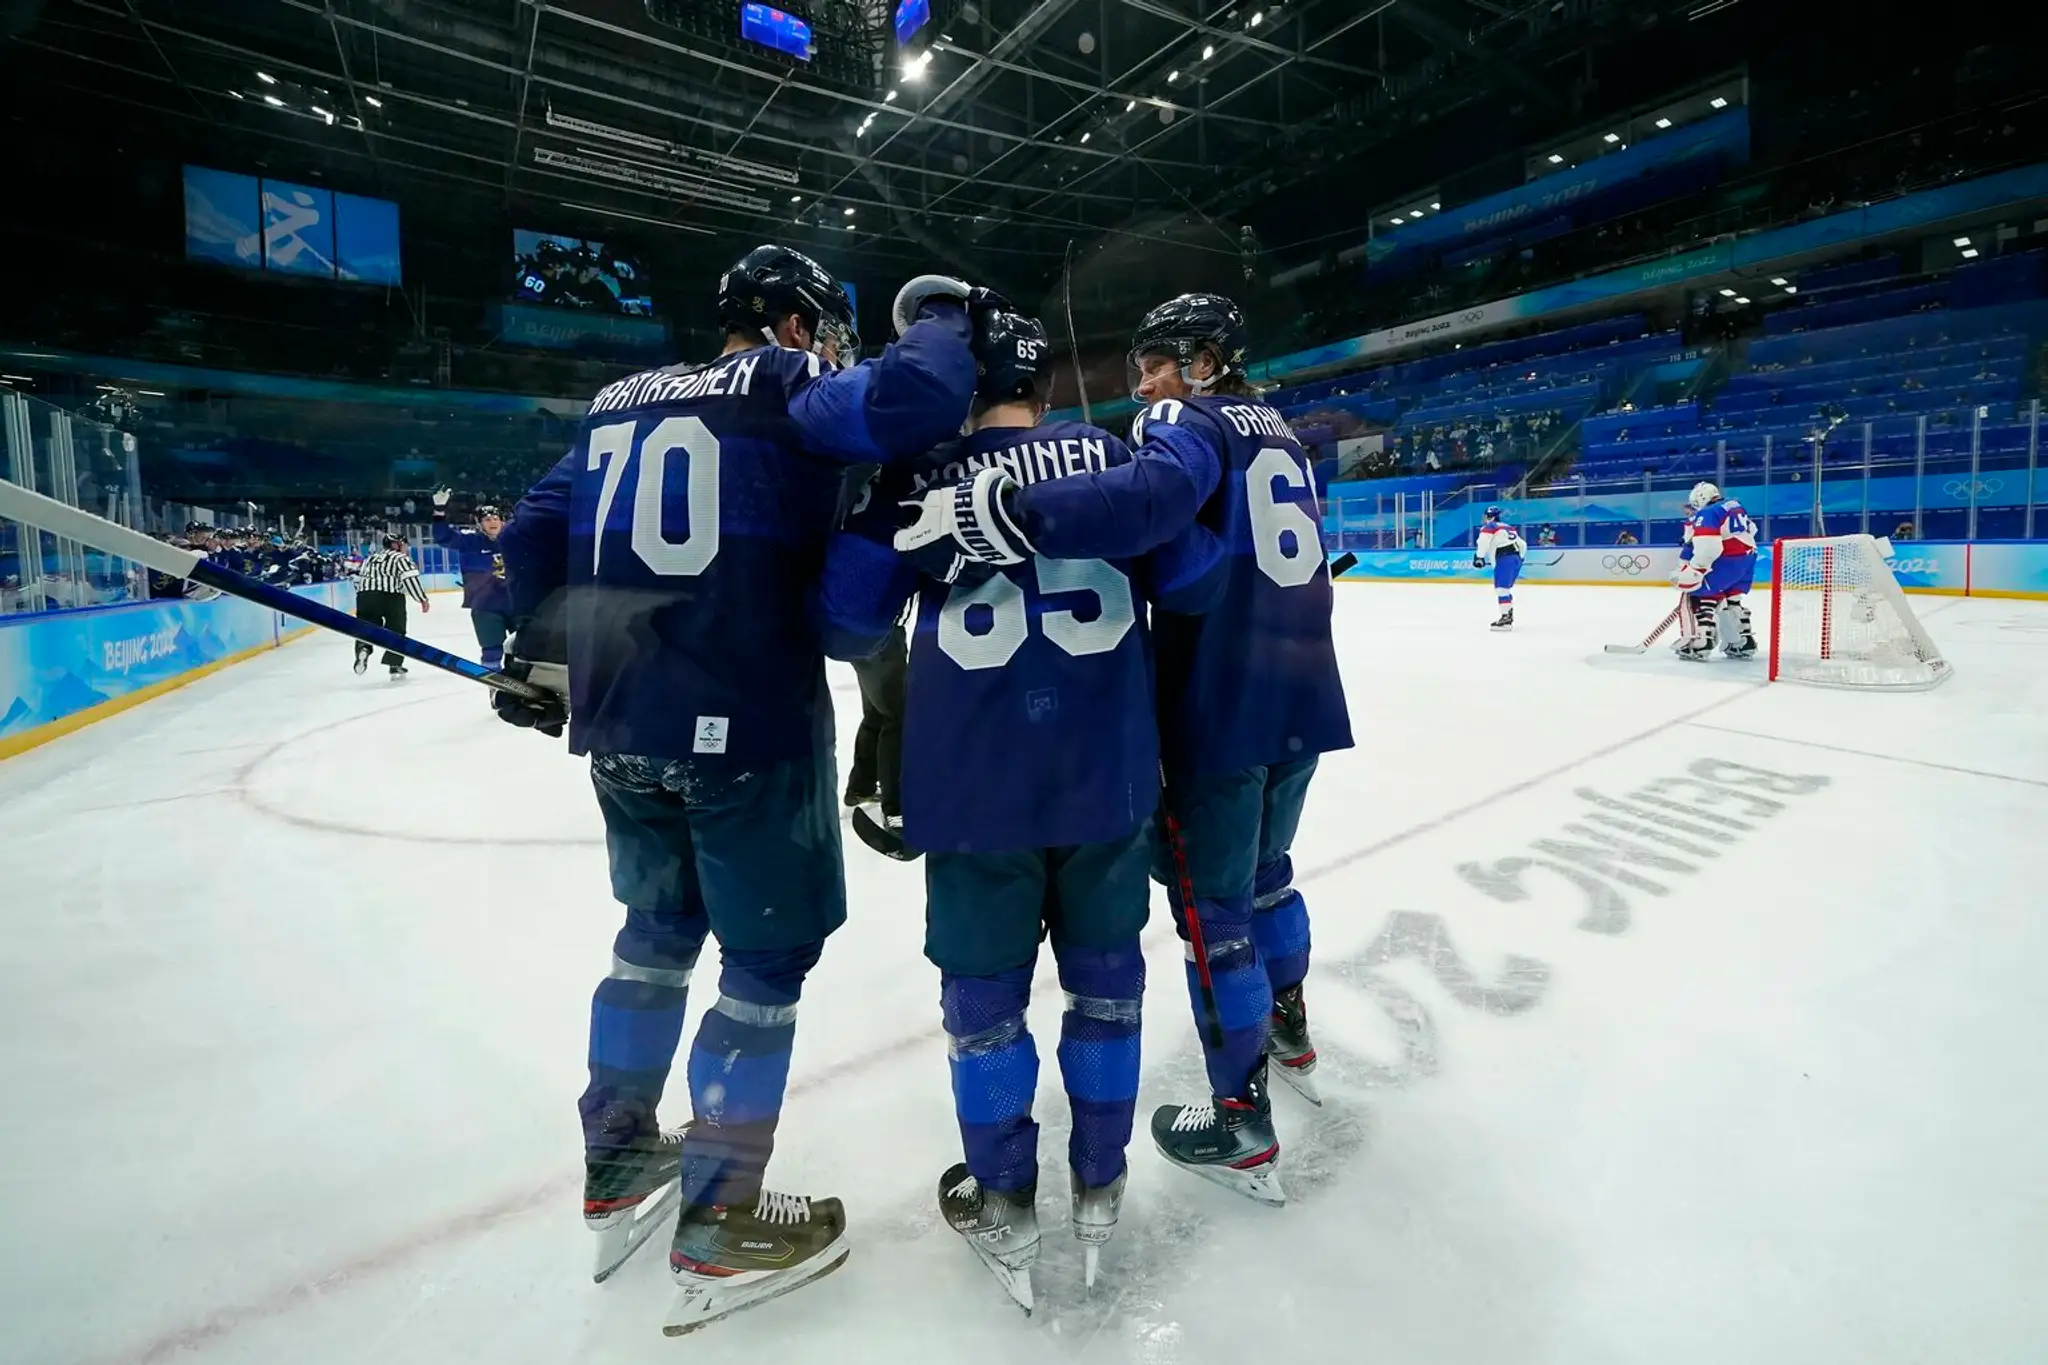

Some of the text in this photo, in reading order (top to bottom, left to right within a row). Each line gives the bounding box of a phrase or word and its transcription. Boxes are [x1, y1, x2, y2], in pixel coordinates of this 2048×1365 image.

[523, 275, 546, 294] 60
[524, 321, 592, 343] BEIJIN
[1016, 338, 1038, 361] 65
[587, 416, 721, 576] 70
[954, 478, 1008, 563] ARRIOR
[1245, 448, 1334, 588] 6
[1409, 559, 1448, 572] BEIJING
[938, 553, 1136, 671] 65
[103, 635, 148, 676] BEIJING
[1456, 756, 1832, 935] BEIJING
[740, 1240, 774, 1250] BAUER
